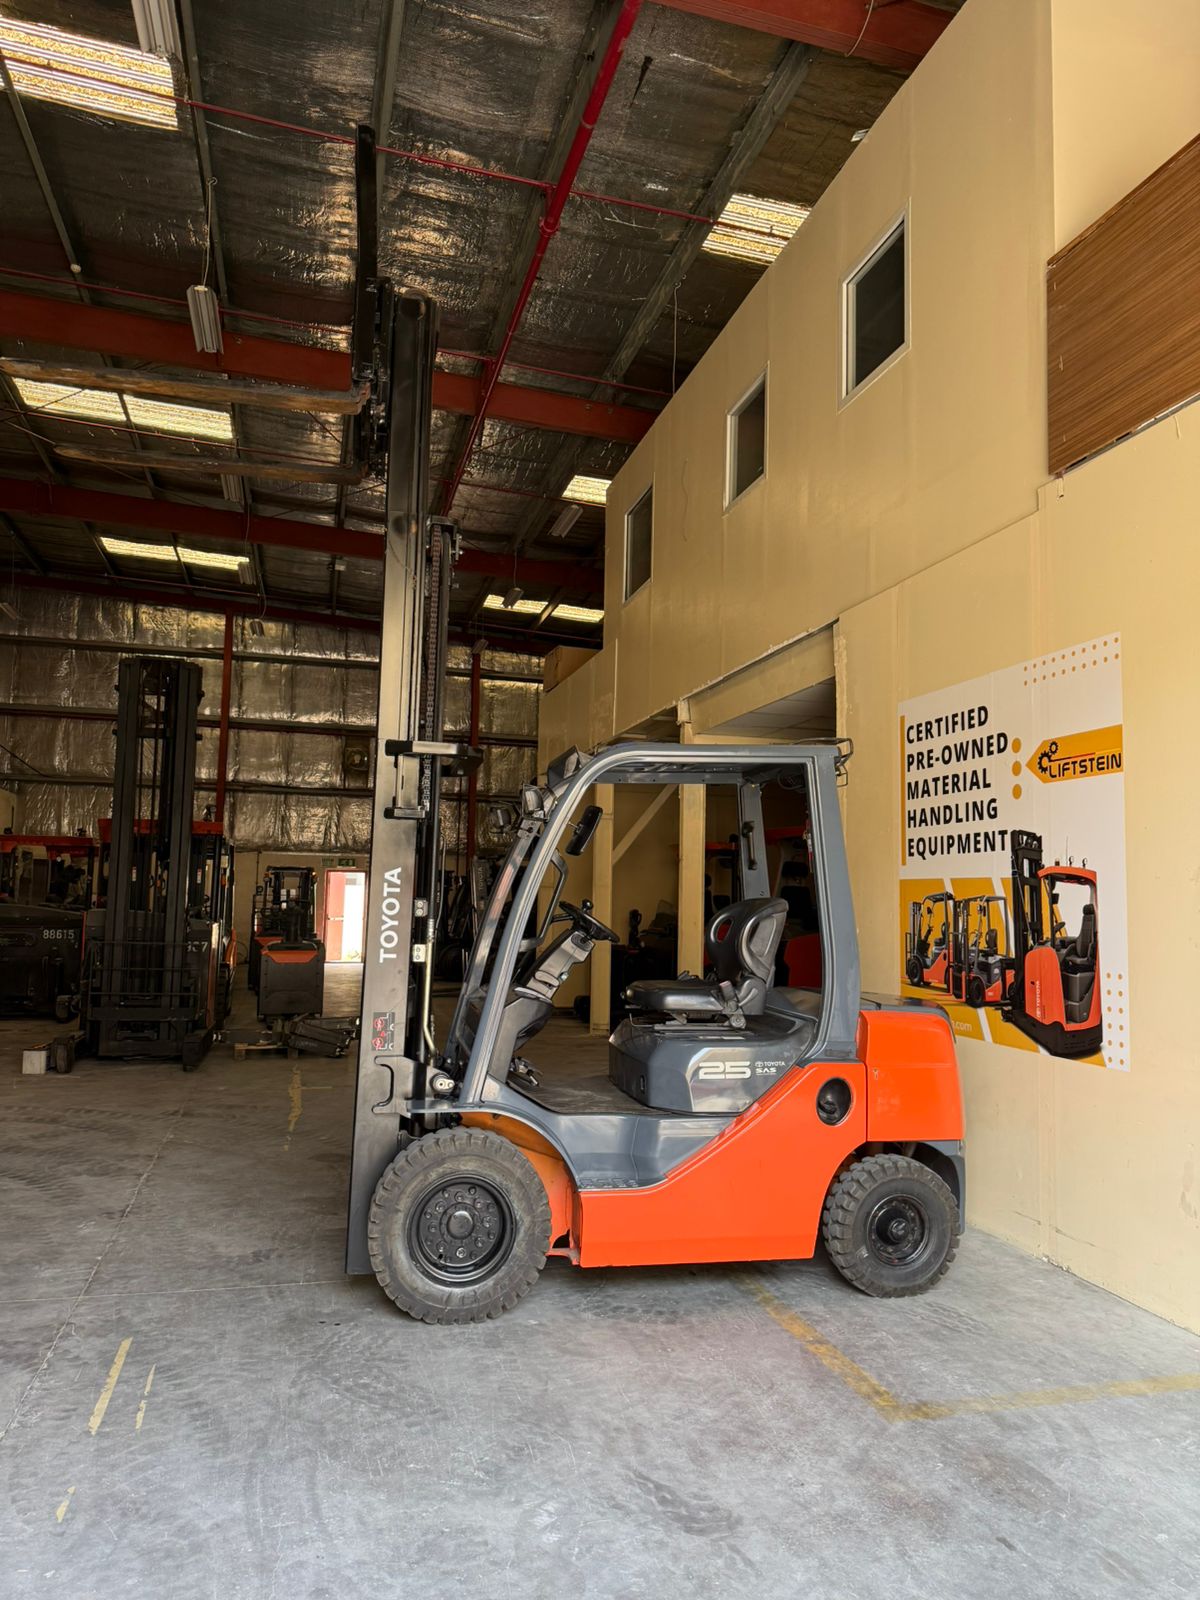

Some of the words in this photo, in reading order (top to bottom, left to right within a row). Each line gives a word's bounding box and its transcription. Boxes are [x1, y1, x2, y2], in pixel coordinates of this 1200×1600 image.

[906, 705, 989, 744] CERTIFIED
[906, 731, 1009, 773] PRE-OWNED
[1048, 752, 1122, 779] LIFTSTEIN
[906, 767, 991, 800] MATERIAL
[906, 797, 999, 829] HANDLING
[906, 829, 1008, 860] EQUIPMENT
[378, 866, 402, 964] TOYOTA
[43, 929, 75, 940] 88615
[698, 1061, 752, 1080] 25
